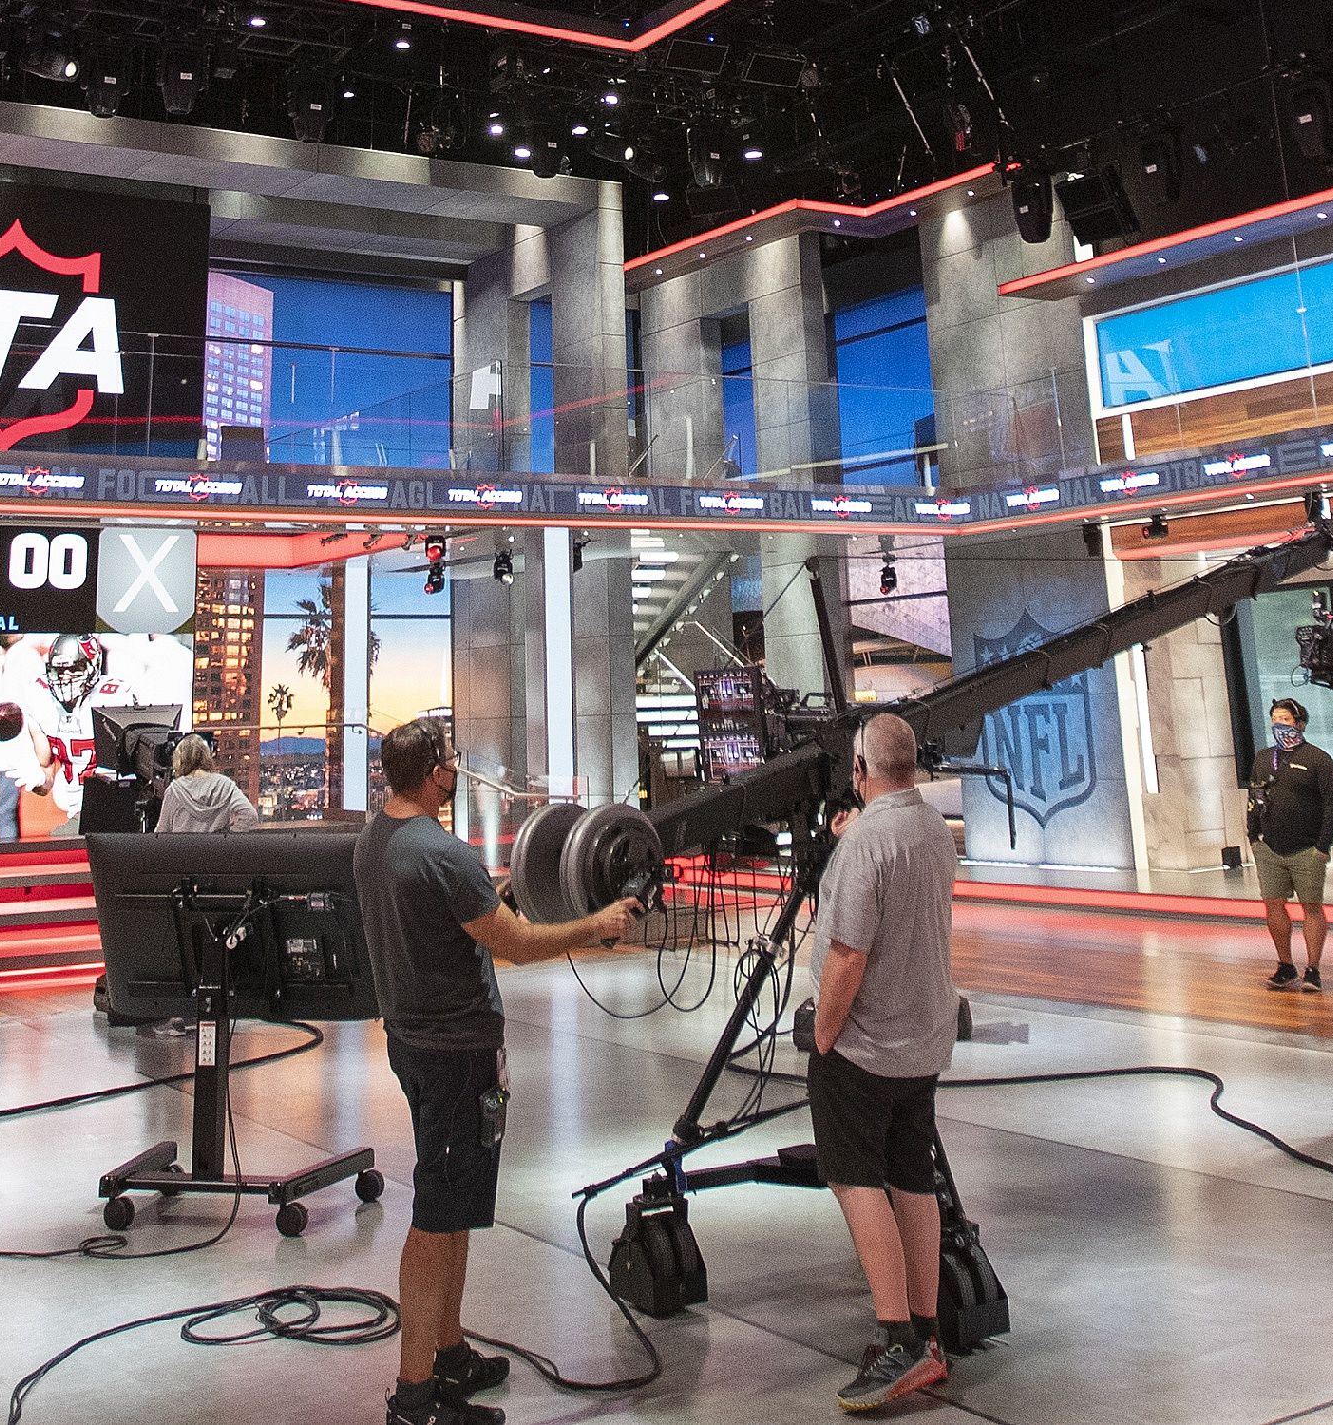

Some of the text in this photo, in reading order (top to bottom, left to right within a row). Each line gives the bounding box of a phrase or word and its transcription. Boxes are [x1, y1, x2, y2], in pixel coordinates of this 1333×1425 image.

[9, 532, 88, 590] 00
[113, 534, 180, 613] X
[991, 702, 1085, 804] NFL
